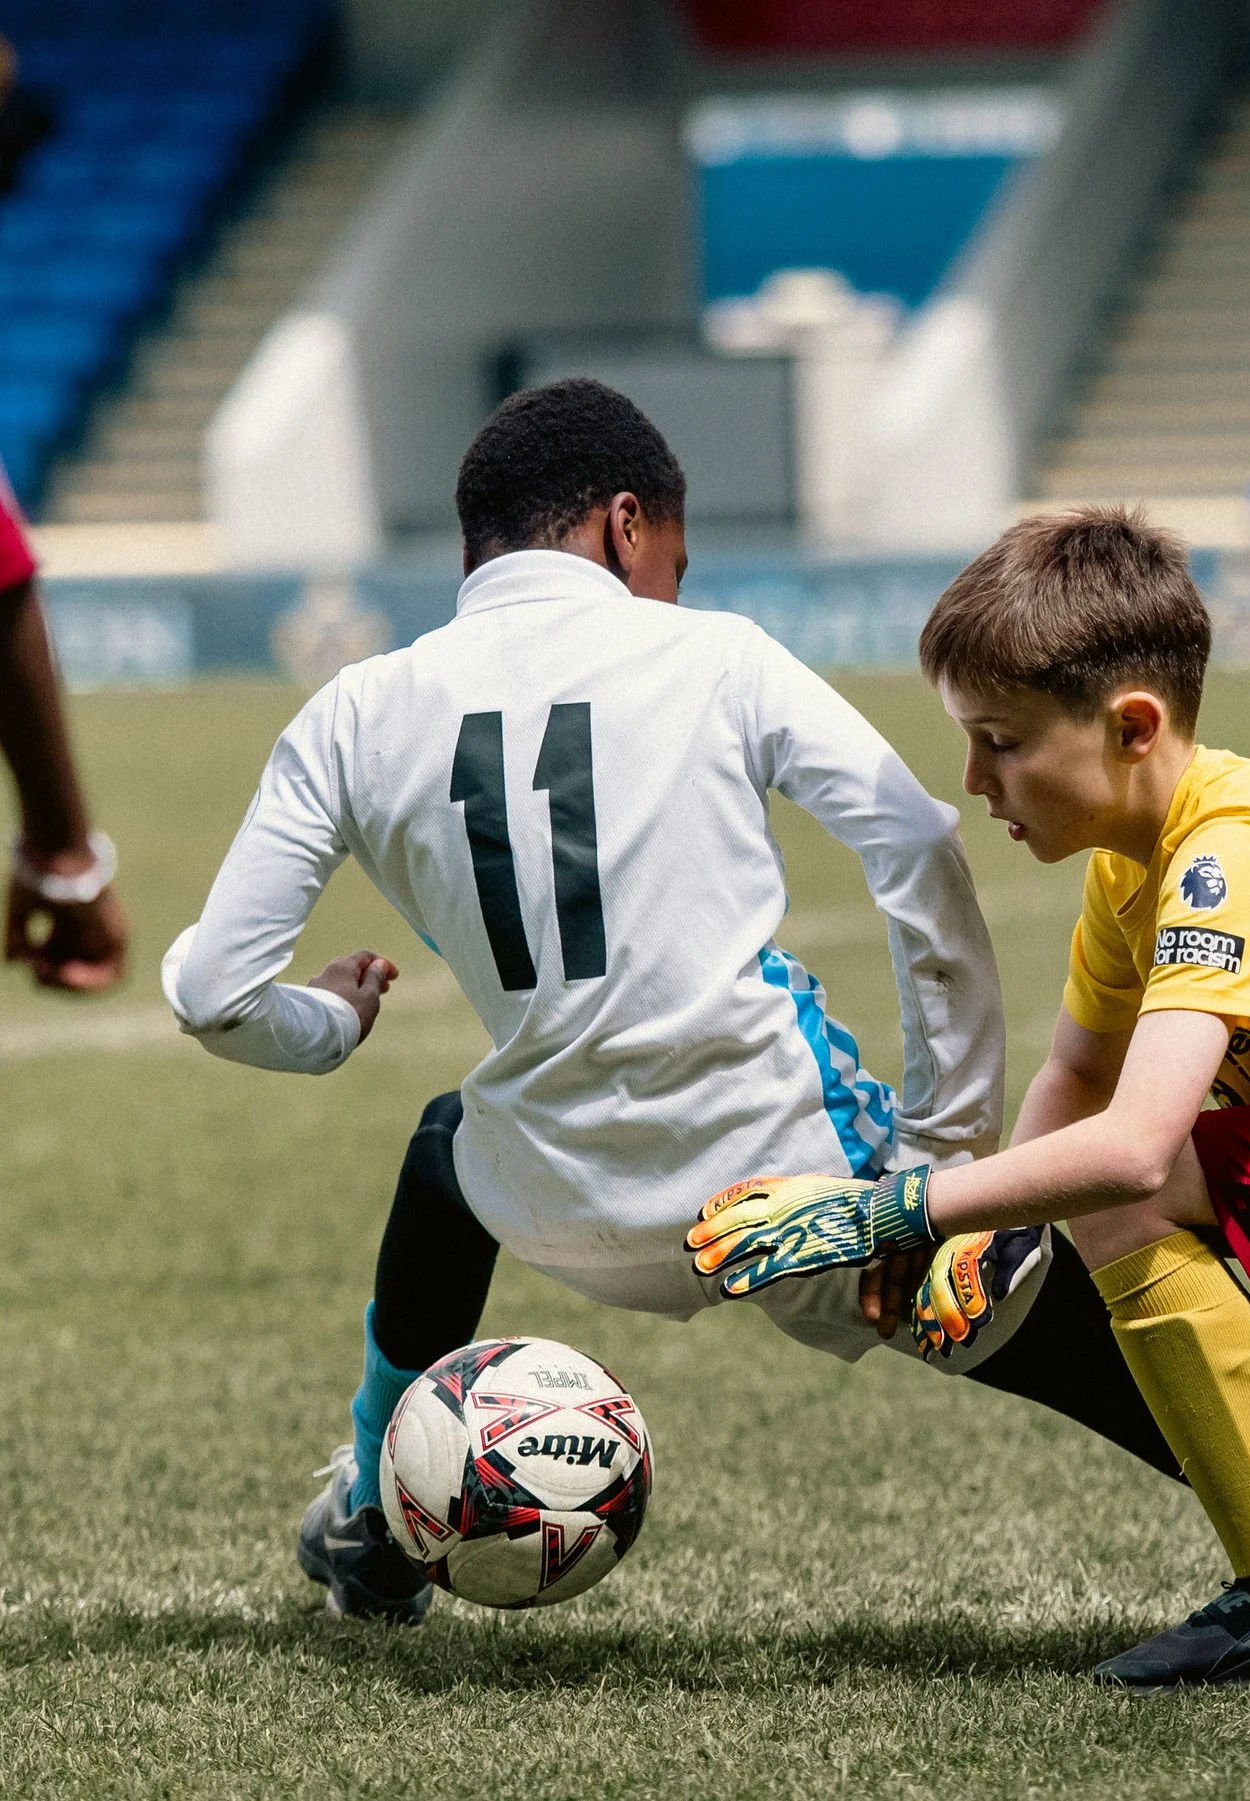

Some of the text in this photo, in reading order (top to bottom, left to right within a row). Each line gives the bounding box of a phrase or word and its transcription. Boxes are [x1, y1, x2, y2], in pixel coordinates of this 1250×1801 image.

[450, 702, 607, 992] 11
[1157, 929, 1236, 954] No room
[1155, 947, 1241, 974] or racism
[714, 1181, 764, 1212] KIPSTA
[957, 1251, 976, 1305] KIPSTA
[528, 1370, 594, 1391] IMPEL
[517, 1434, 621, 1469] Mitre
